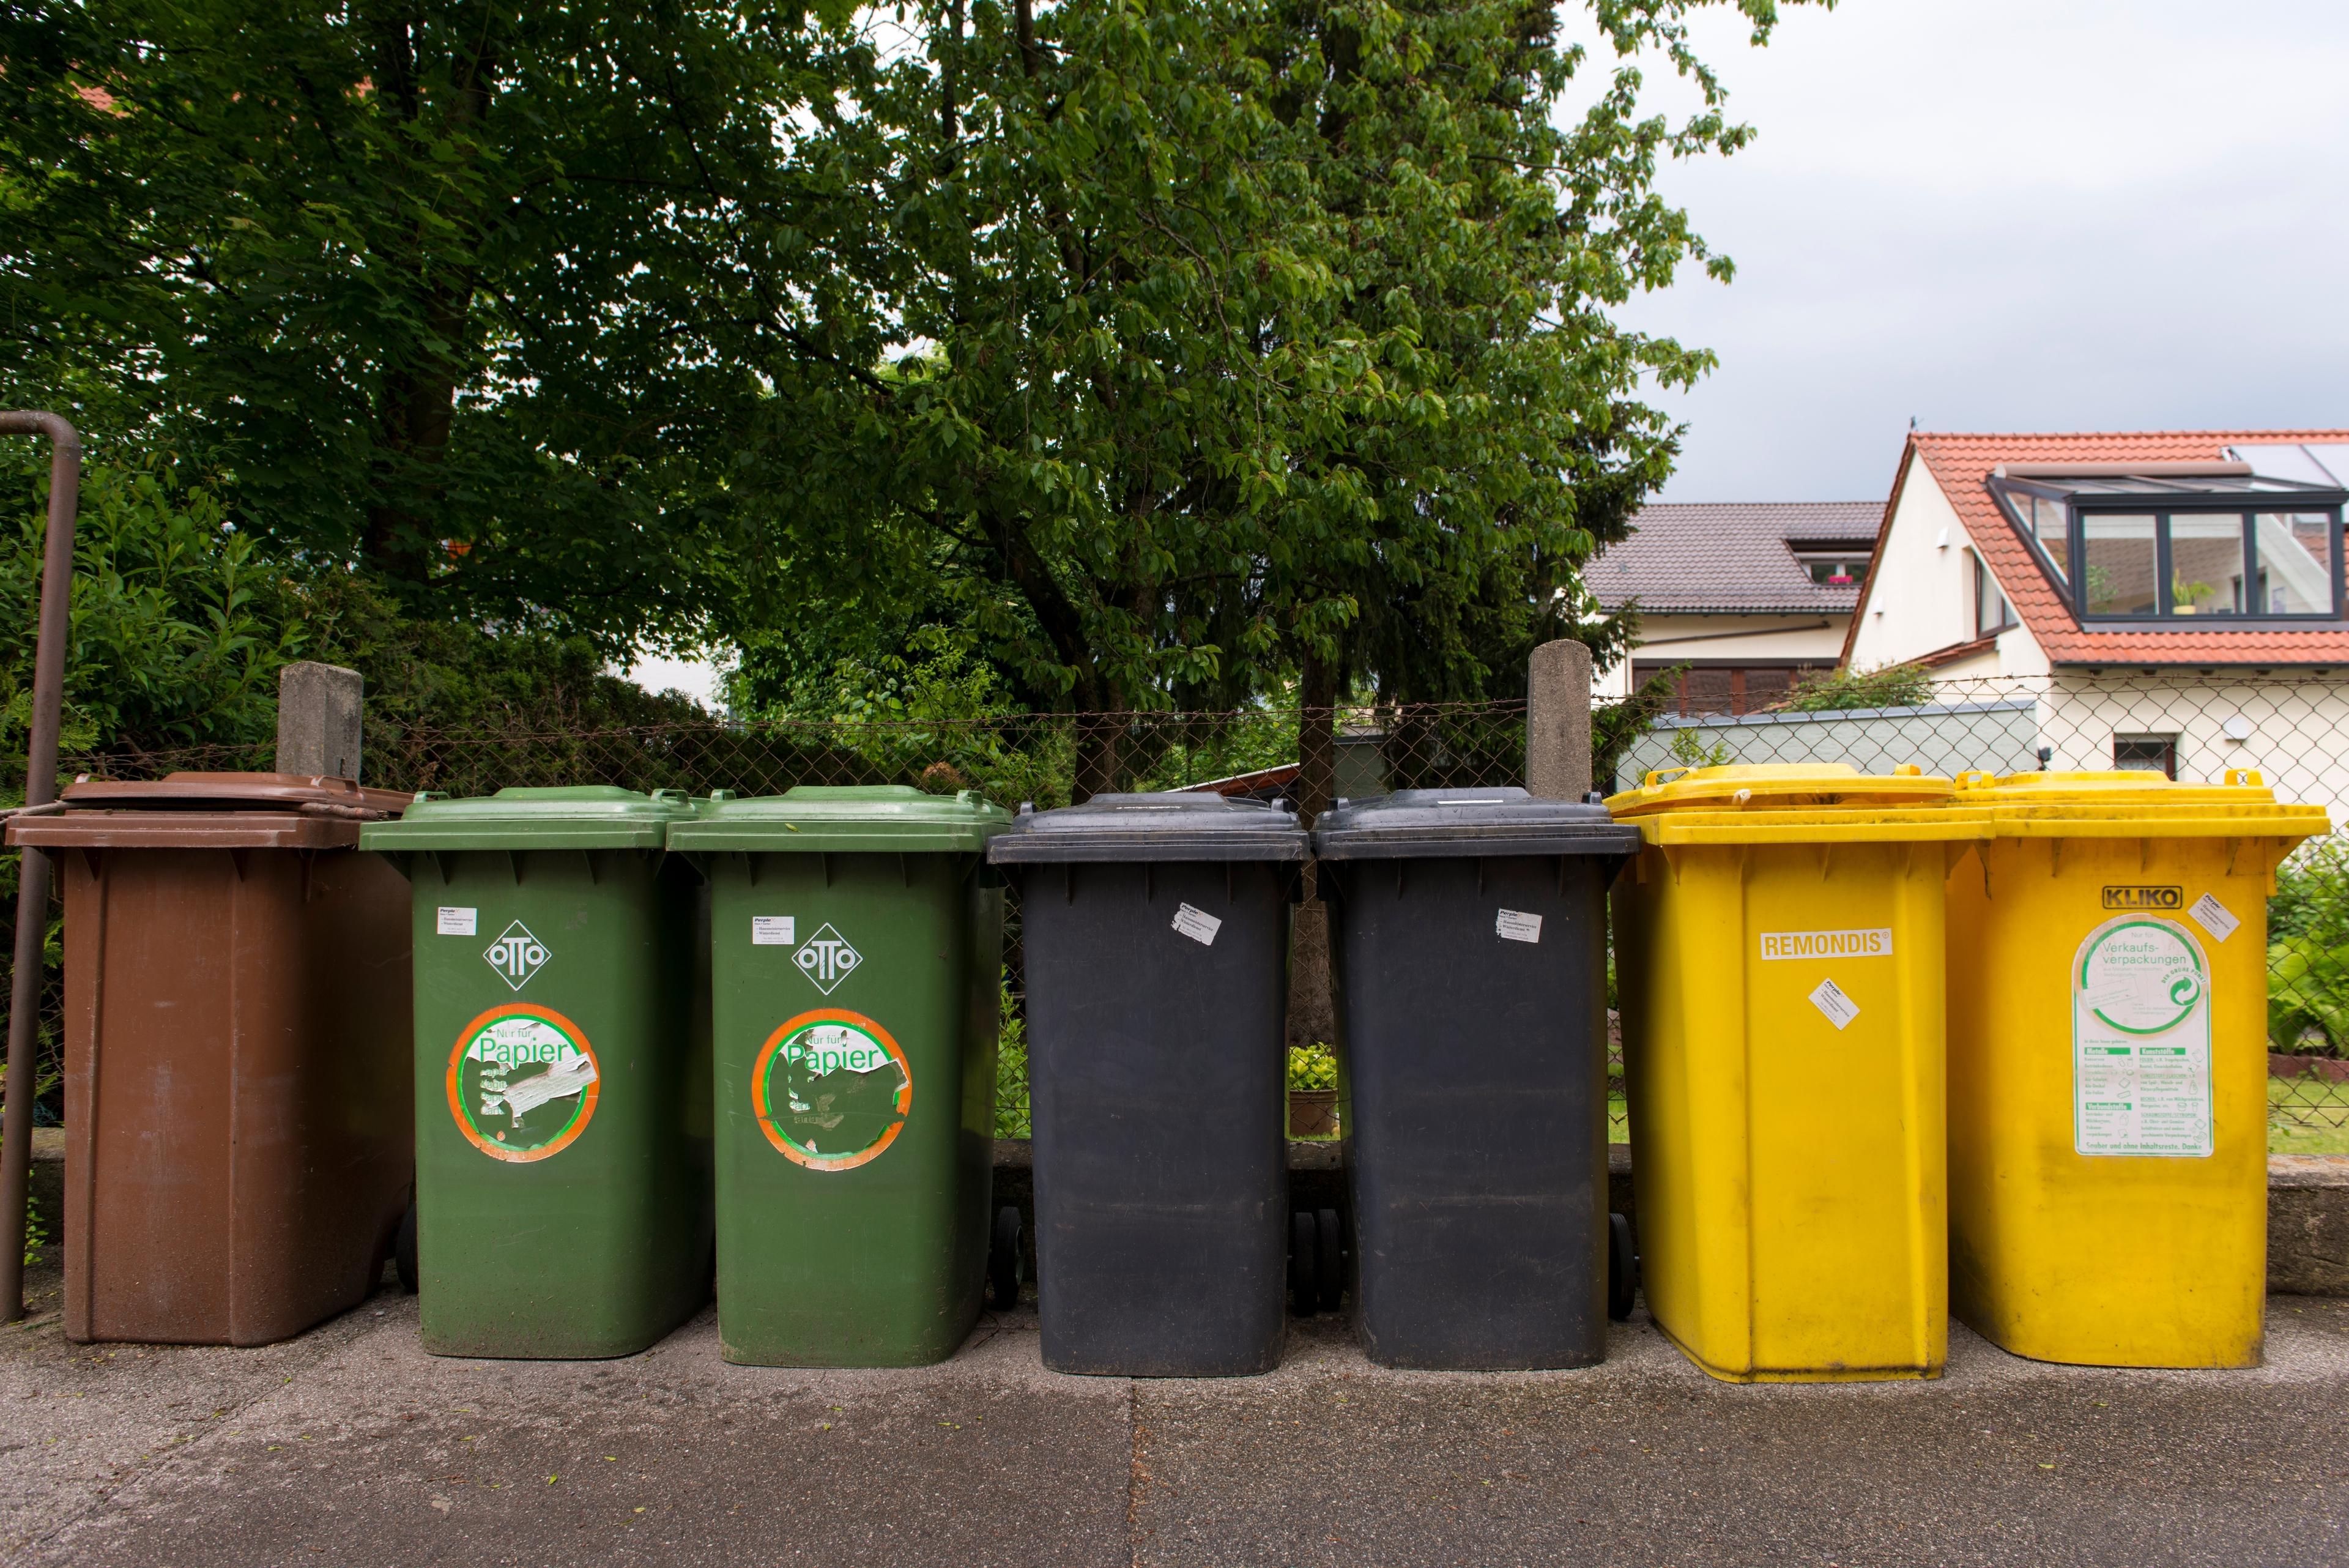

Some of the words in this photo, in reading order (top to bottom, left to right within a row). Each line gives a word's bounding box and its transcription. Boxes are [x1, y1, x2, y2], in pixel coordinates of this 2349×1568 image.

[2106, 889, 2178, 906] KLIKO
[489, 937, 544, 975] OTTO
[2102, 942, 2159, 953] Verkaufs-
[798, 940, 855, 979] OTTO
[2103, 954, 2186, 965] verpackungen
[2161, 974, 2170, 983] DER
[826, 1035, 842, 1044] für
[480, 1037, 568, 1069] Papier
[787, 1044, 879, 1077] Papier
